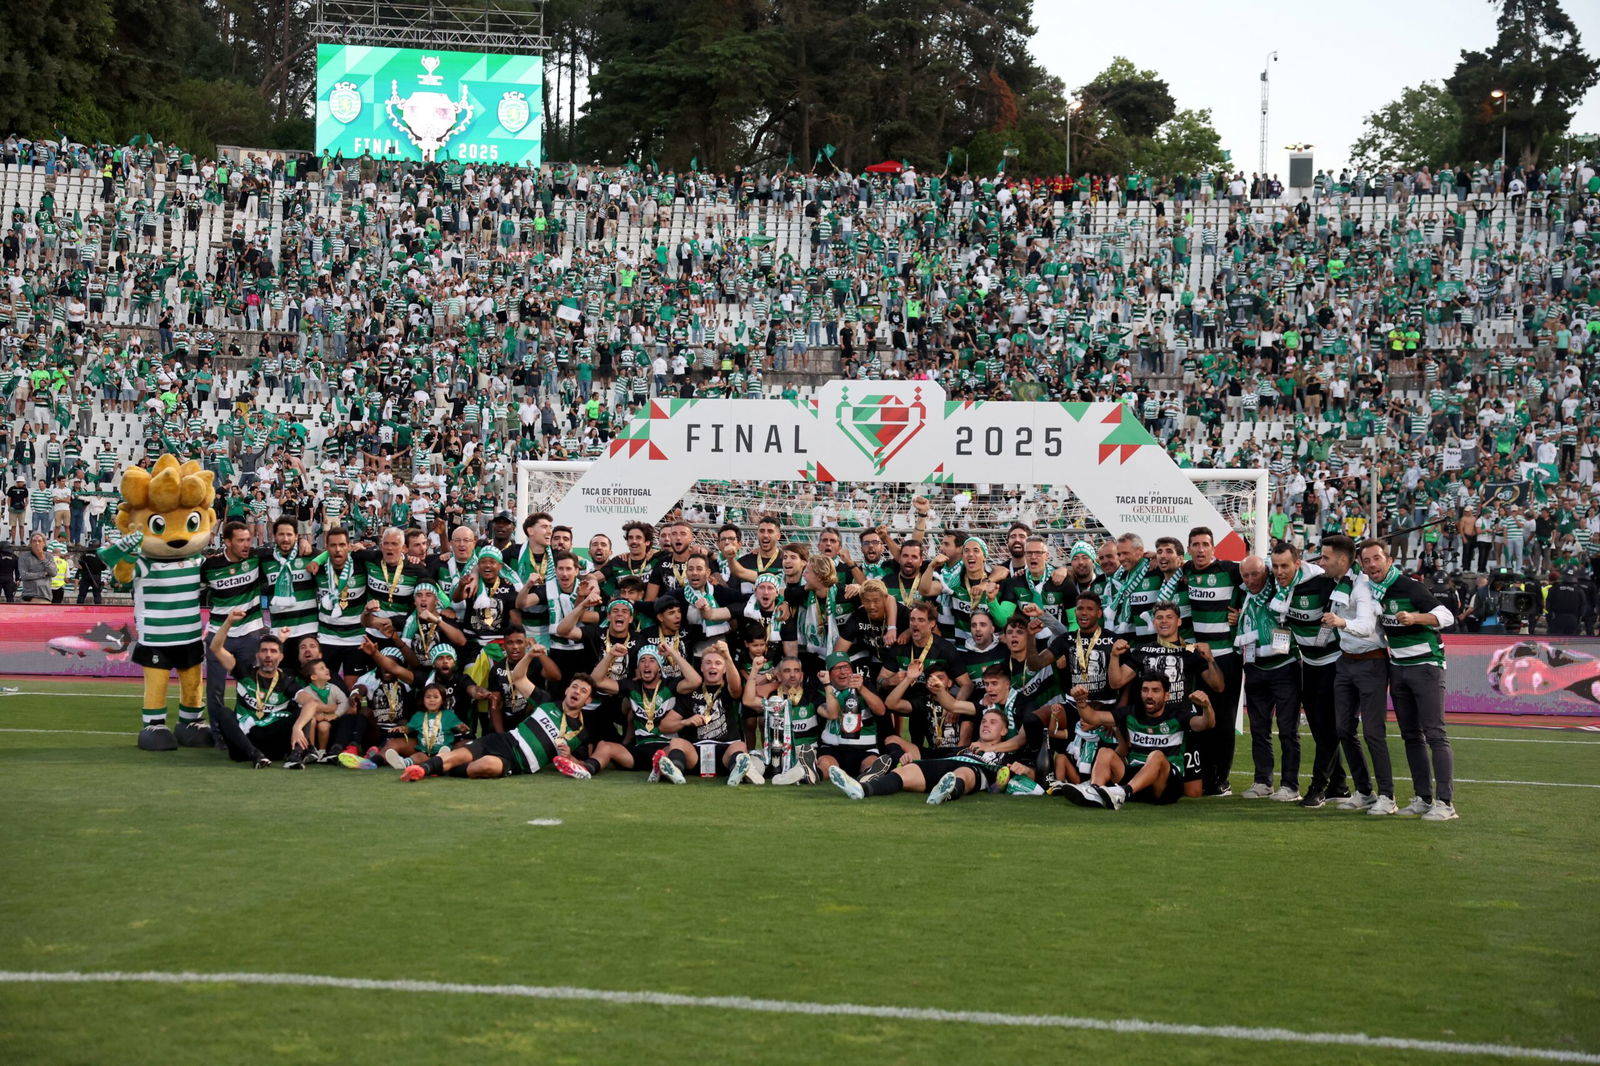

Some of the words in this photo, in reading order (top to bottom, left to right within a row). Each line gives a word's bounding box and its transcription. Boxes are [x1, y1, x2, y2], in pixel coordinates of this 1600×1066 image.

[354, 137, 402, 155] FINAL
[458, 143, 498, 160] 2025
[686, 423, 808, 454] FINAL
[955, 426, 1062, 457] 2025
[601, 487, 613, 496] DE
[613, 488, 652, 497] PORTUGAL
[596, 496, 636, 505] GENERALI
[1137, 496, 1149, 504] DE
[1150, 496, 1194, 505] PORTUGAL
[584, 504, 648, 514] TRANQUILIDADE
[1132, 505, 1176, 514] GENERALI
[1119, 513, 1190, 523] TRANQUILIDADE
[216, 574, 251, 588] Betano
[1133, 733, 1169, 745] Betano
[1183, 750, 1201, 769] 20
